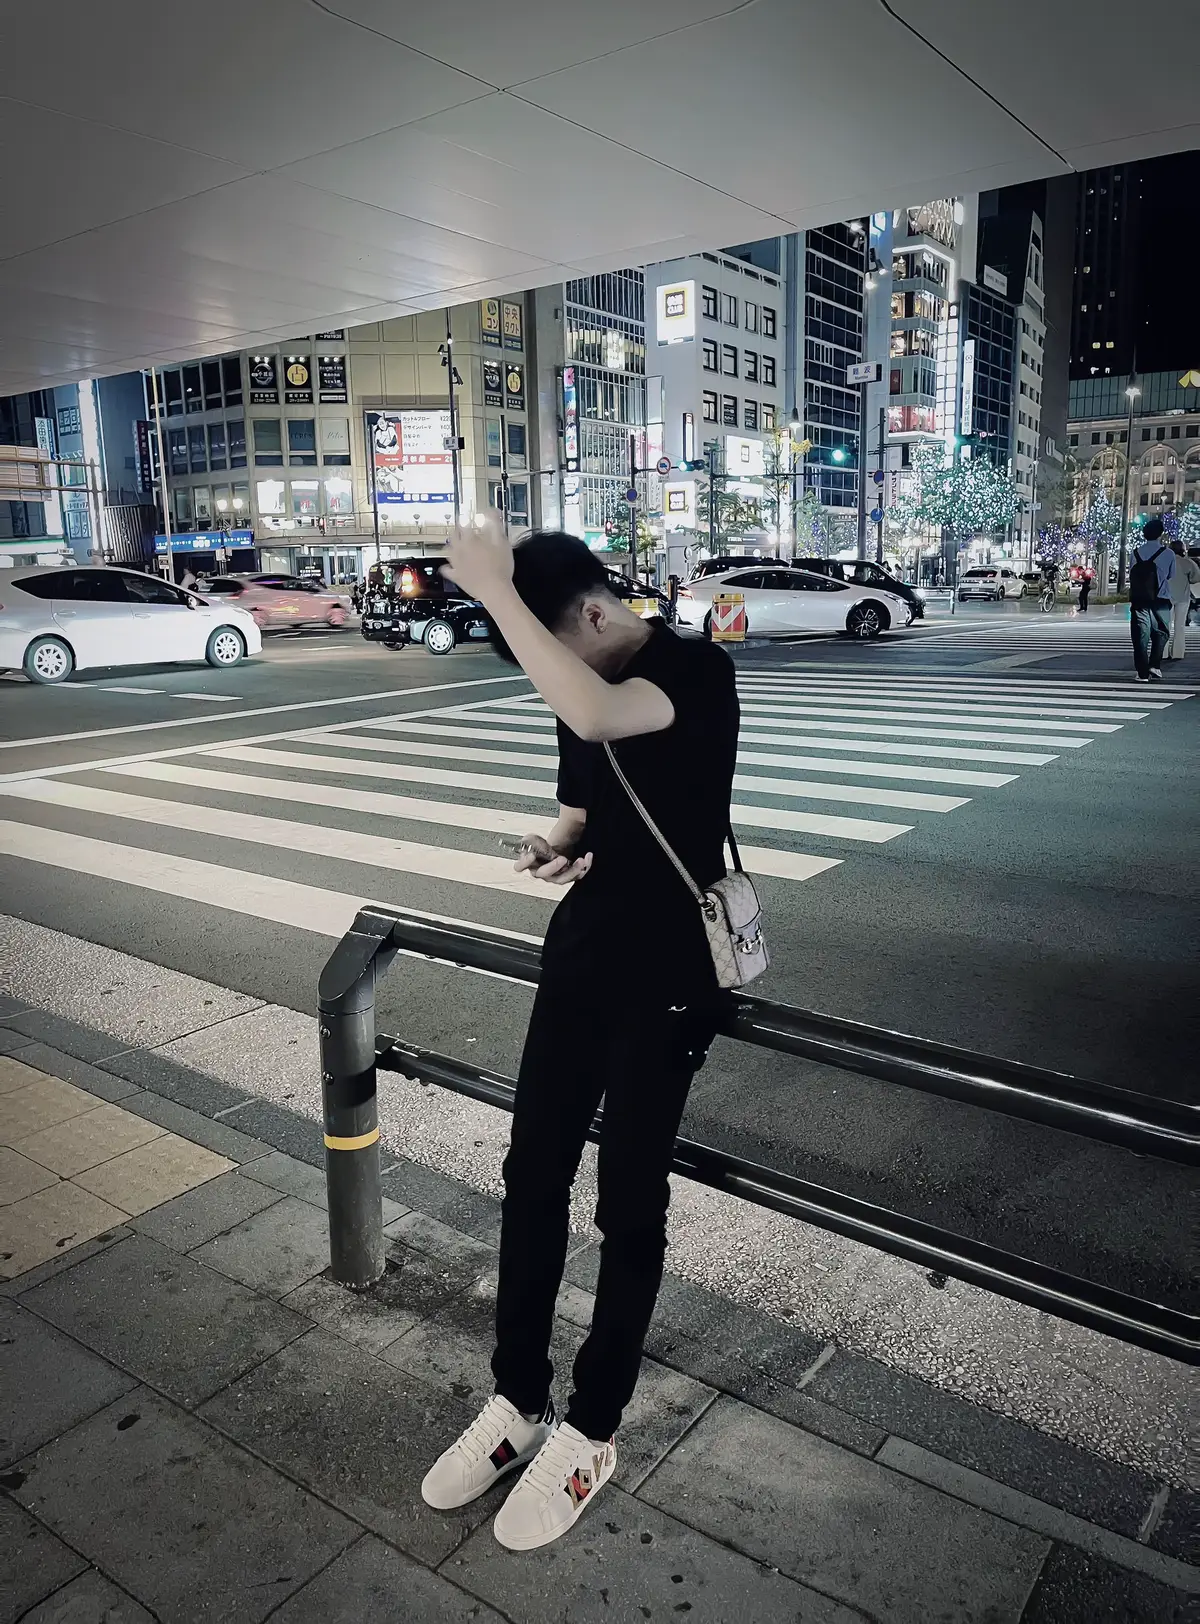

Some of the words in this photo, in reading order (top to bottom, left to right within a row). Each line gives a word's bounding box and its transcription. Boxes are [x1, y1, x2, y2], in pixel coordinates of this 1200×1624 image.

[505, 306, 518, 320] 中央
[487, 317, 498, 329] コン
[505, 321, 519, 334] タクト
